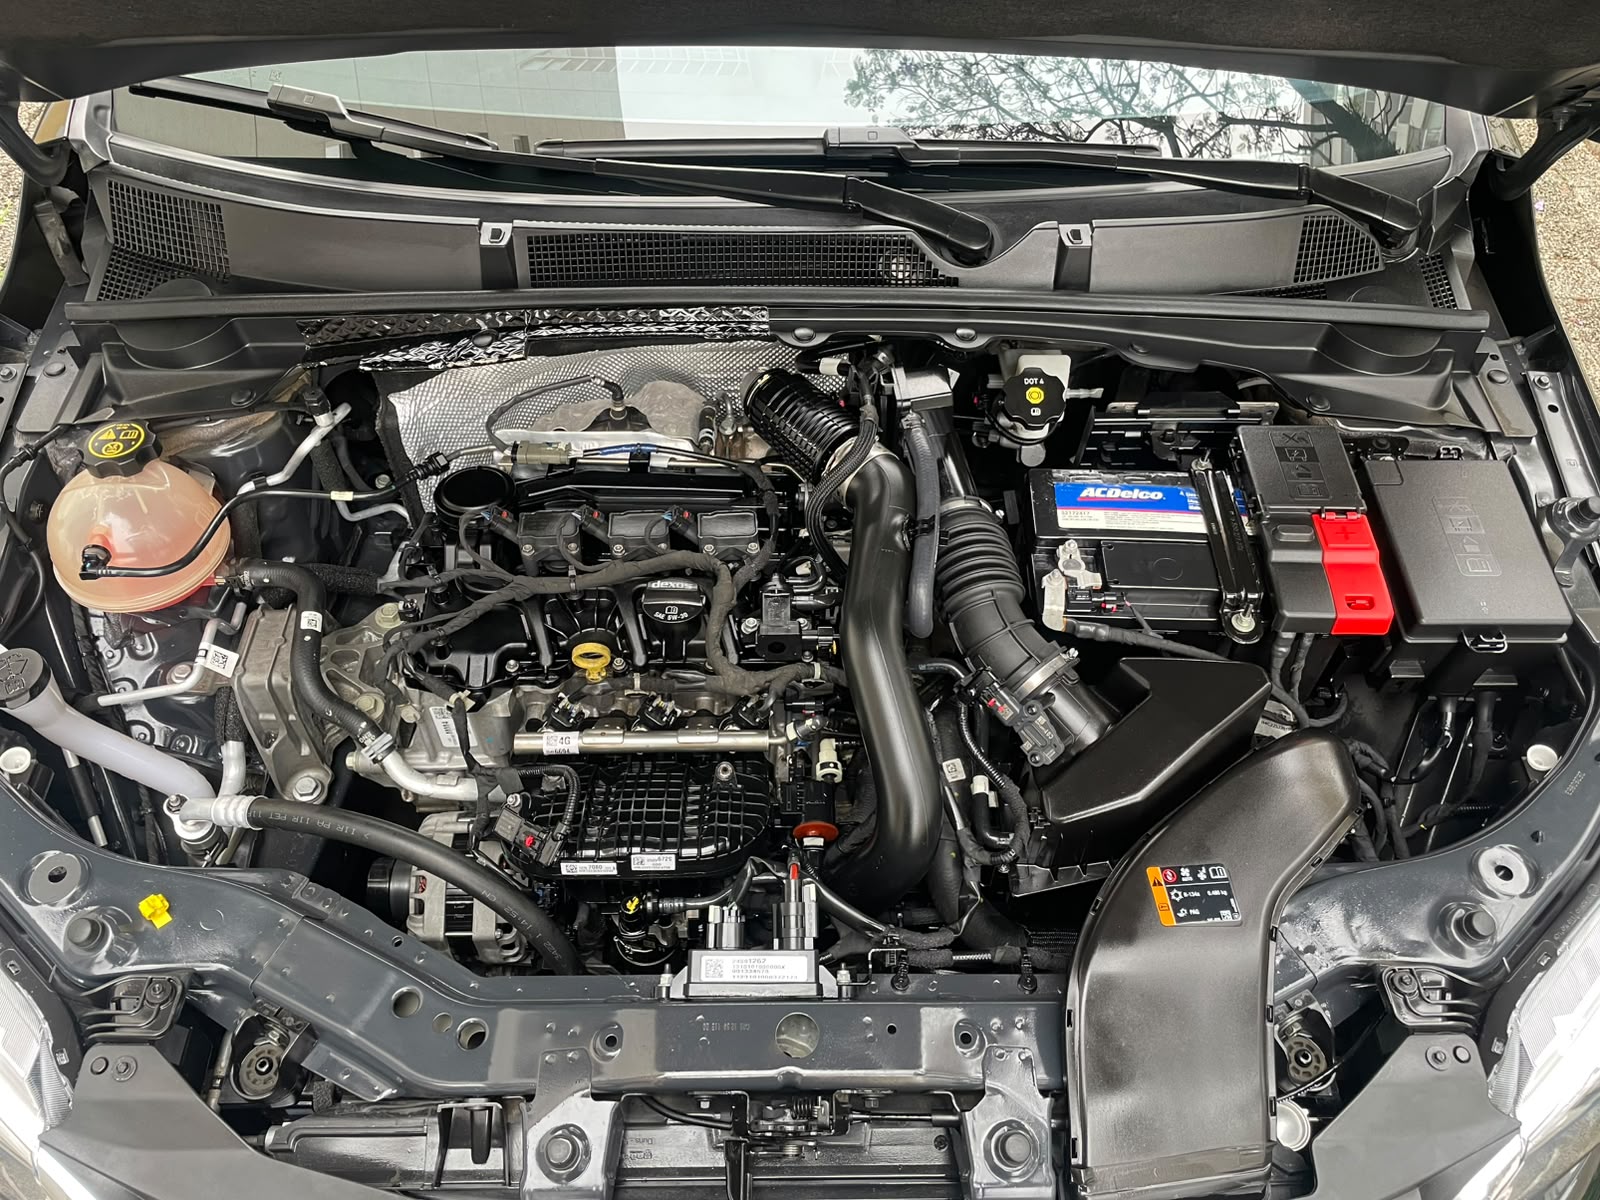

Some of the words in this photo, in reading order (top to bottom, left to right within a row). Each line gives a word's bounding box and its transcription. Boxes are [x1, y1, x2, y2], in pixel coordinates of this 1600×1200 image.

[1079, 487, 1164, 500] ACDelco
[651, 580, 694, 589] dexos
[653, 611, 666, 620] SAE
[667, 612, 689, 620] 5W-30
